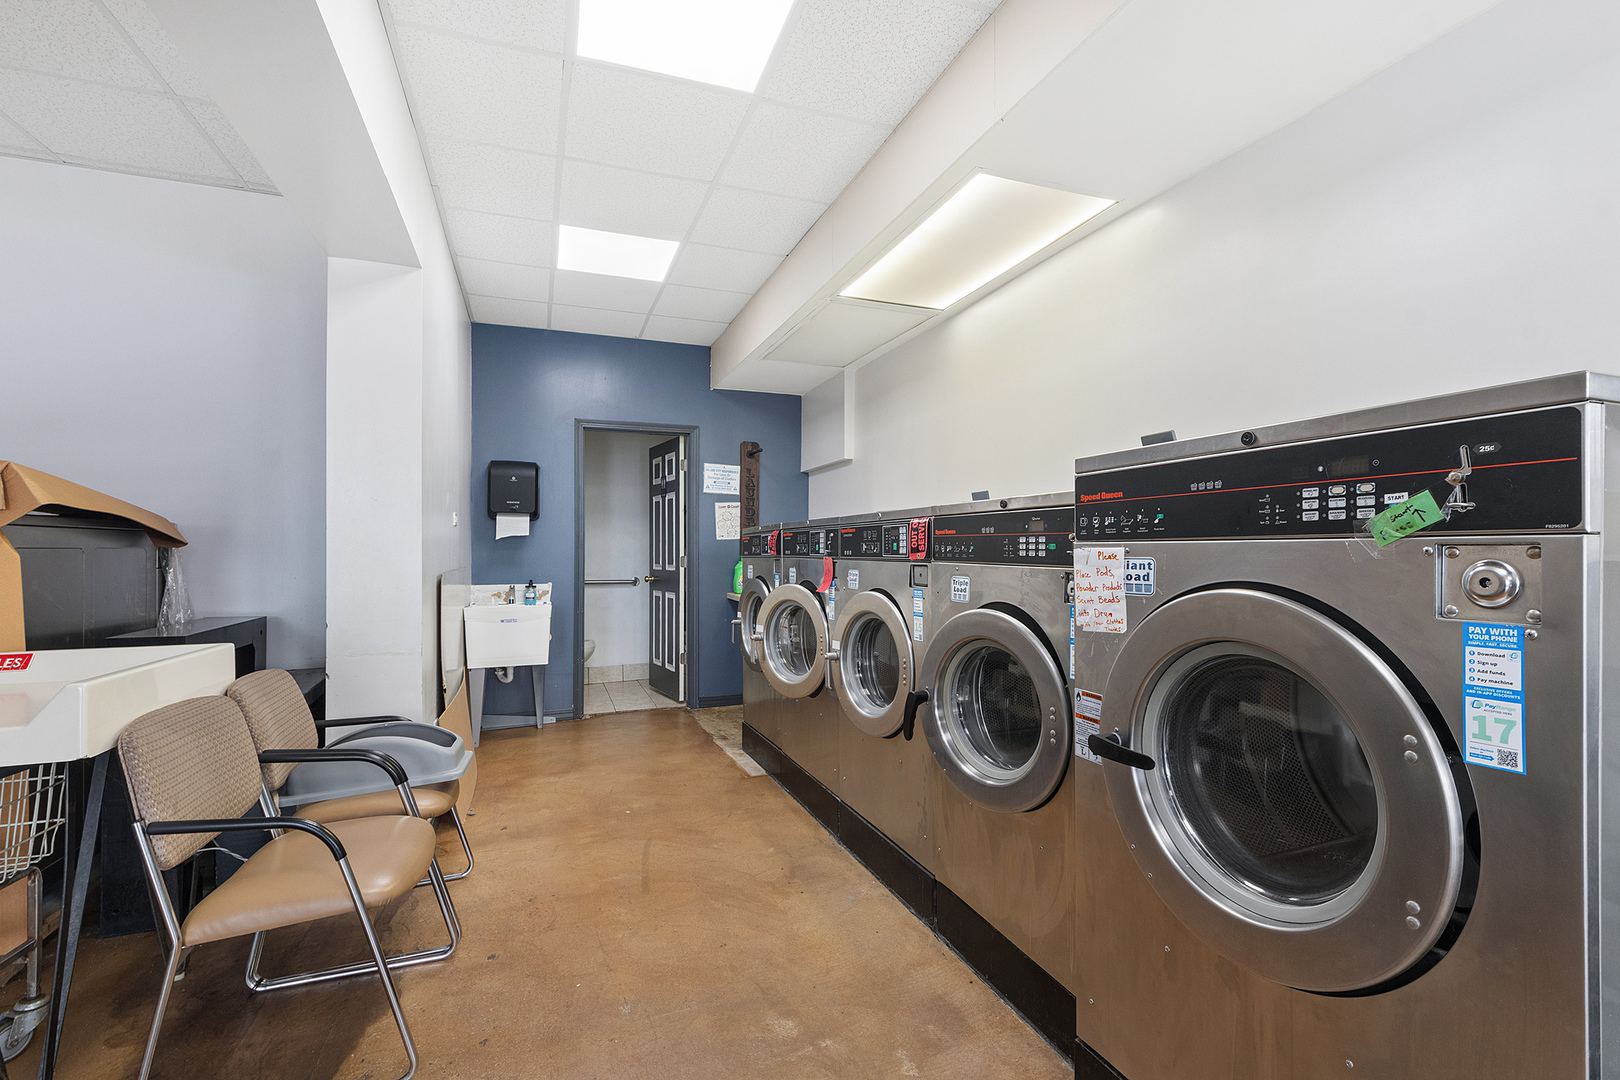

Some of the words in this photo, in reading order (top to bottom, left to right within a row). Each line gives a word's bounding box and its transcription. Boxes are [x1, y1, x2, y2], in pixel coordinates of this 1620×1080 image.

[1080, 492, 1100, 502] Speed
[1101, 491, 1123, 499] Queen
[1097, 551, 1119, 561] Please
[1124, 560, 1152, 570] iant
[1124, 572, 1150, 581] oad
[1094, 608, 1113, 618] Drum
[1468, 626, 1487, 634] PAY
[1489, 628, 1517, 636] WITH
[0, 657, 22, 668] ES
[1472, 715, 1517, 744] 17
